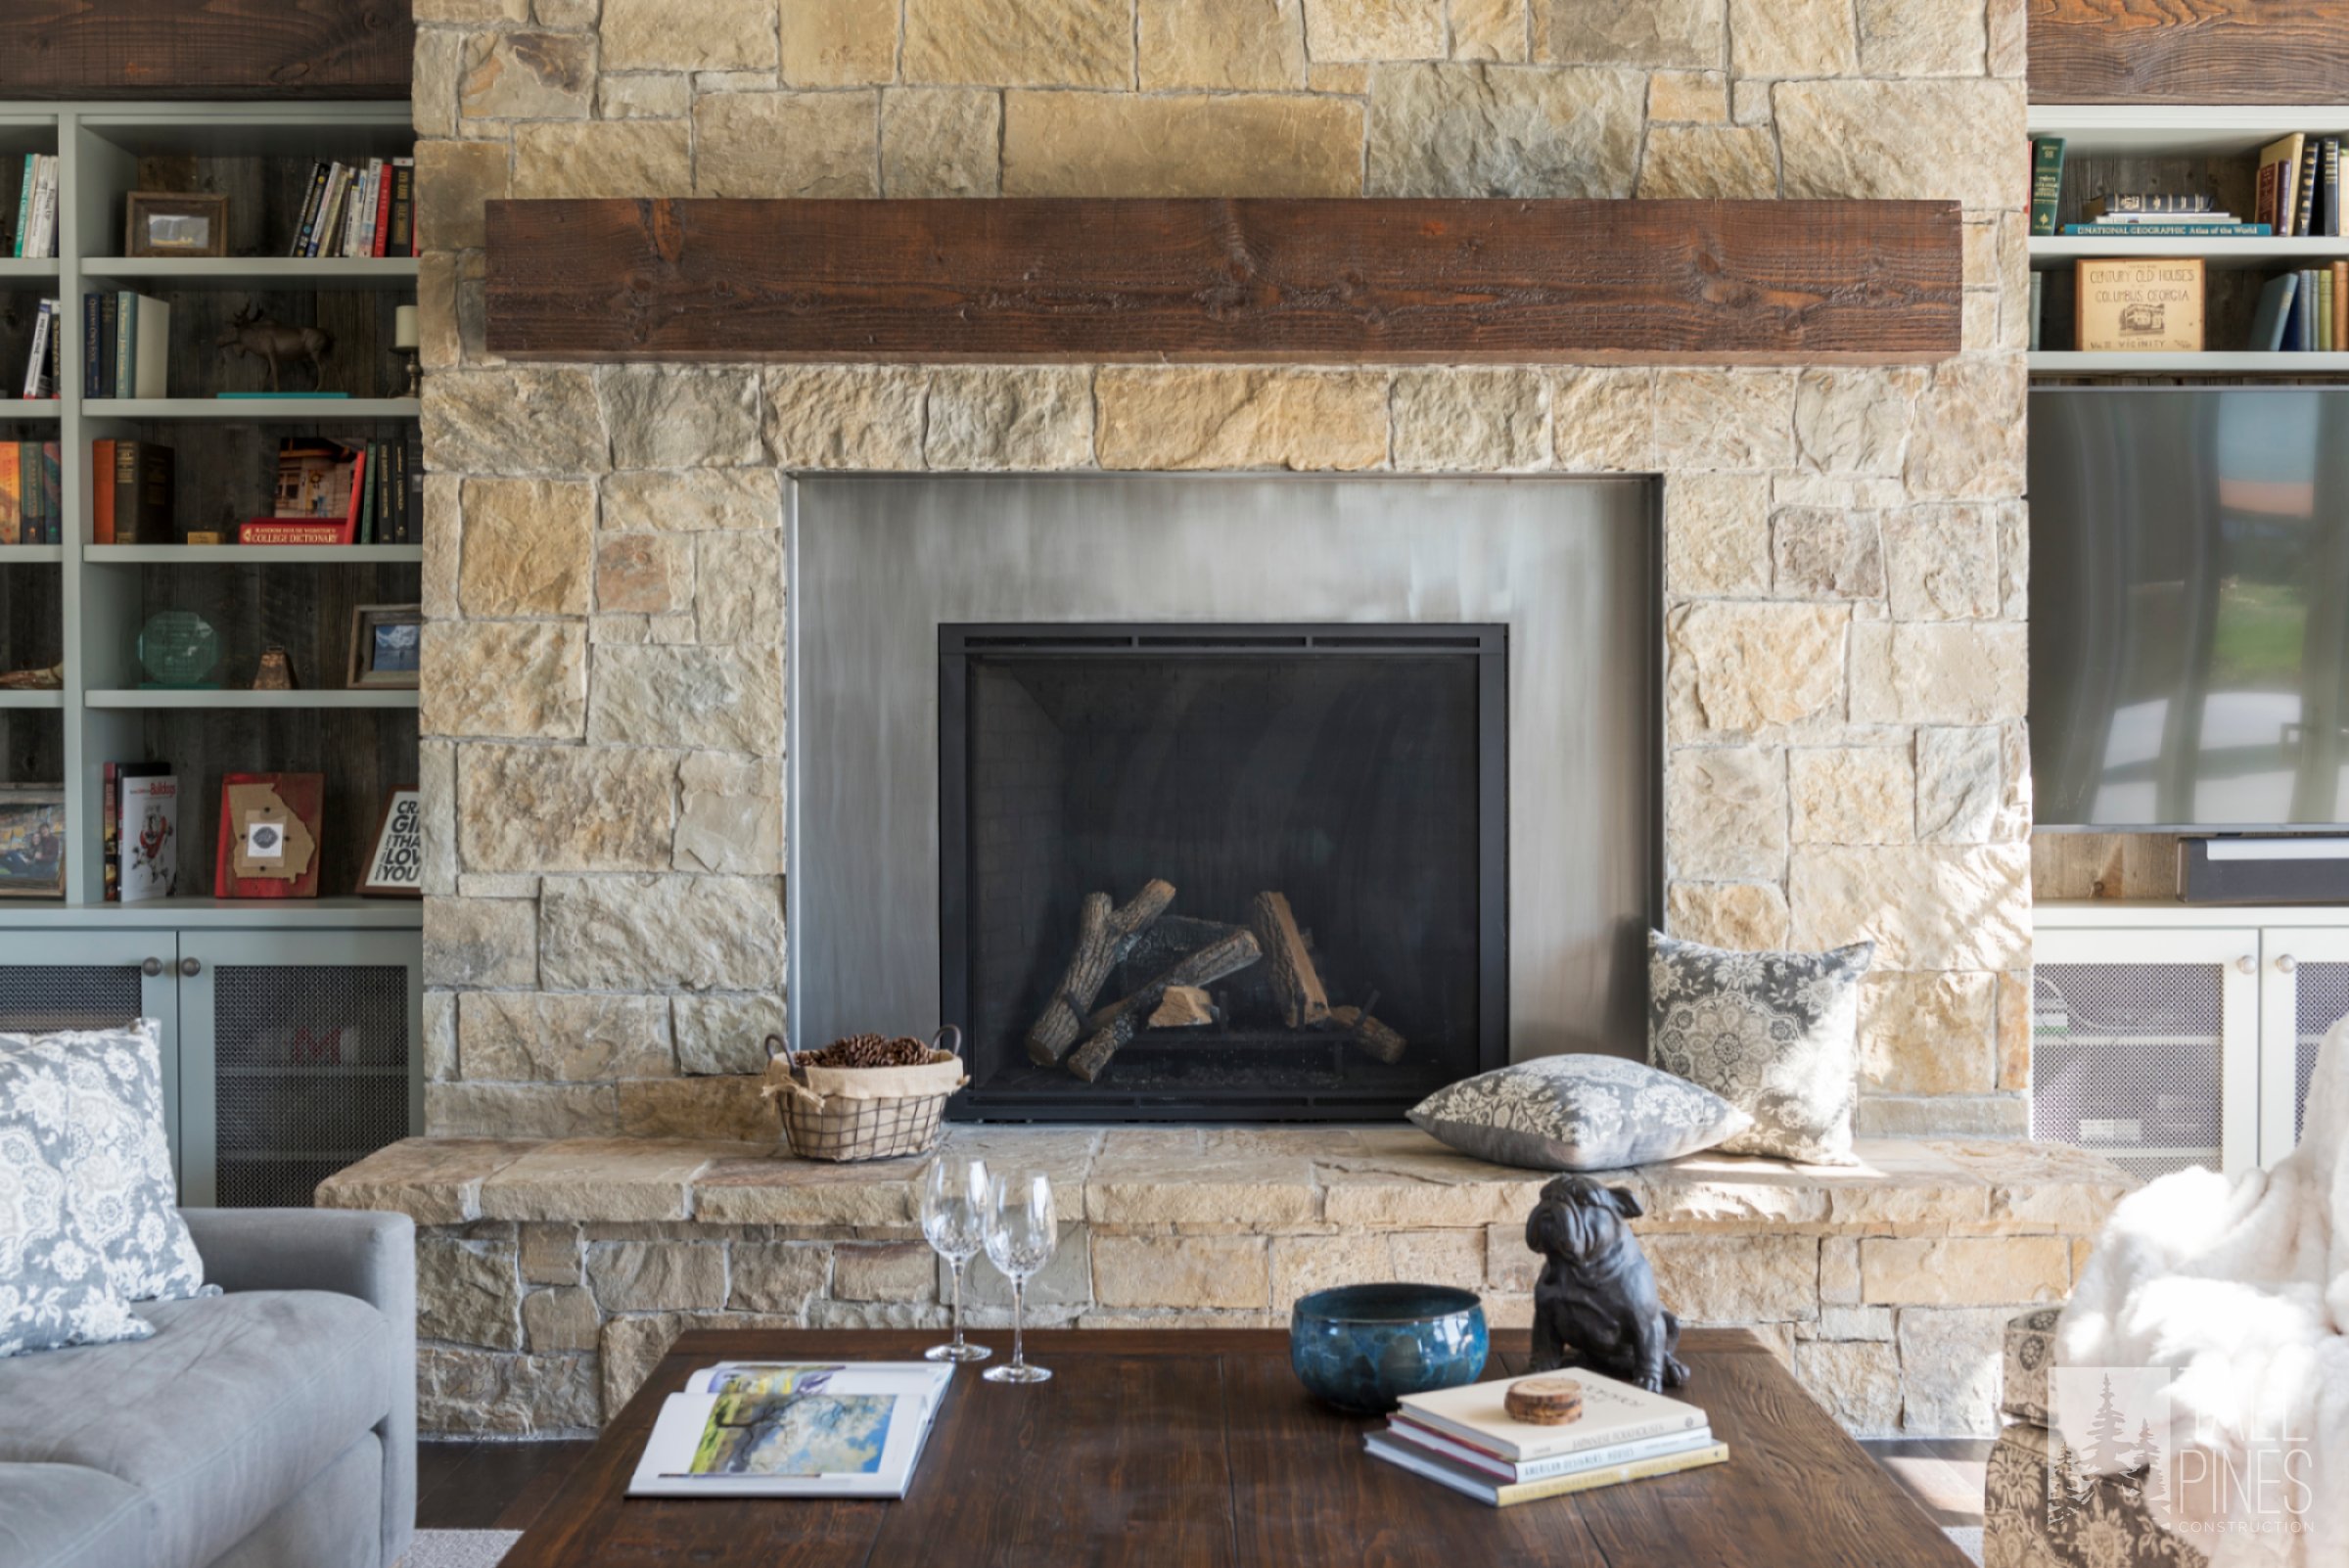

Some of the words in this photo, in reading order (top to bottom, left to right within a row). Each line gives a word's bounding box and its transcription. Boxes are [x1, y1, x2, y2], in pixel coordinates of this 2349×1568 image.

[2131, 226, 2187, 235] GEOGRAPHIC
[2188, 226, 2209, 235] Atlas
[2210, 226, 2220, 235] of
[2220, 226, 2233, 235] the
[2234, 226, 2258, 235] World
[2090, 269, 2131, 284] CENTURY
[2136, 269, 2155, 283] OLD
[2159, 268, 2194, 282] HOUSES
[2096, 290, 2143, 303] COLUMBUS
[2147, 289, 2189, 302] GEORGIA
[2119, 340, 2166, 348] VICINITY
[252, 533, 288, 542] COLLEGE
[289, 533, 338, 542] DICTIONARY
[382, 865, 420, 882] YOU
[1573, 1433, 1611, 1451] JAPANESE
[1524, 1457, 1561, 1477] AMERICAN
[1607, 1448, 1635, 1461] HOUSES
